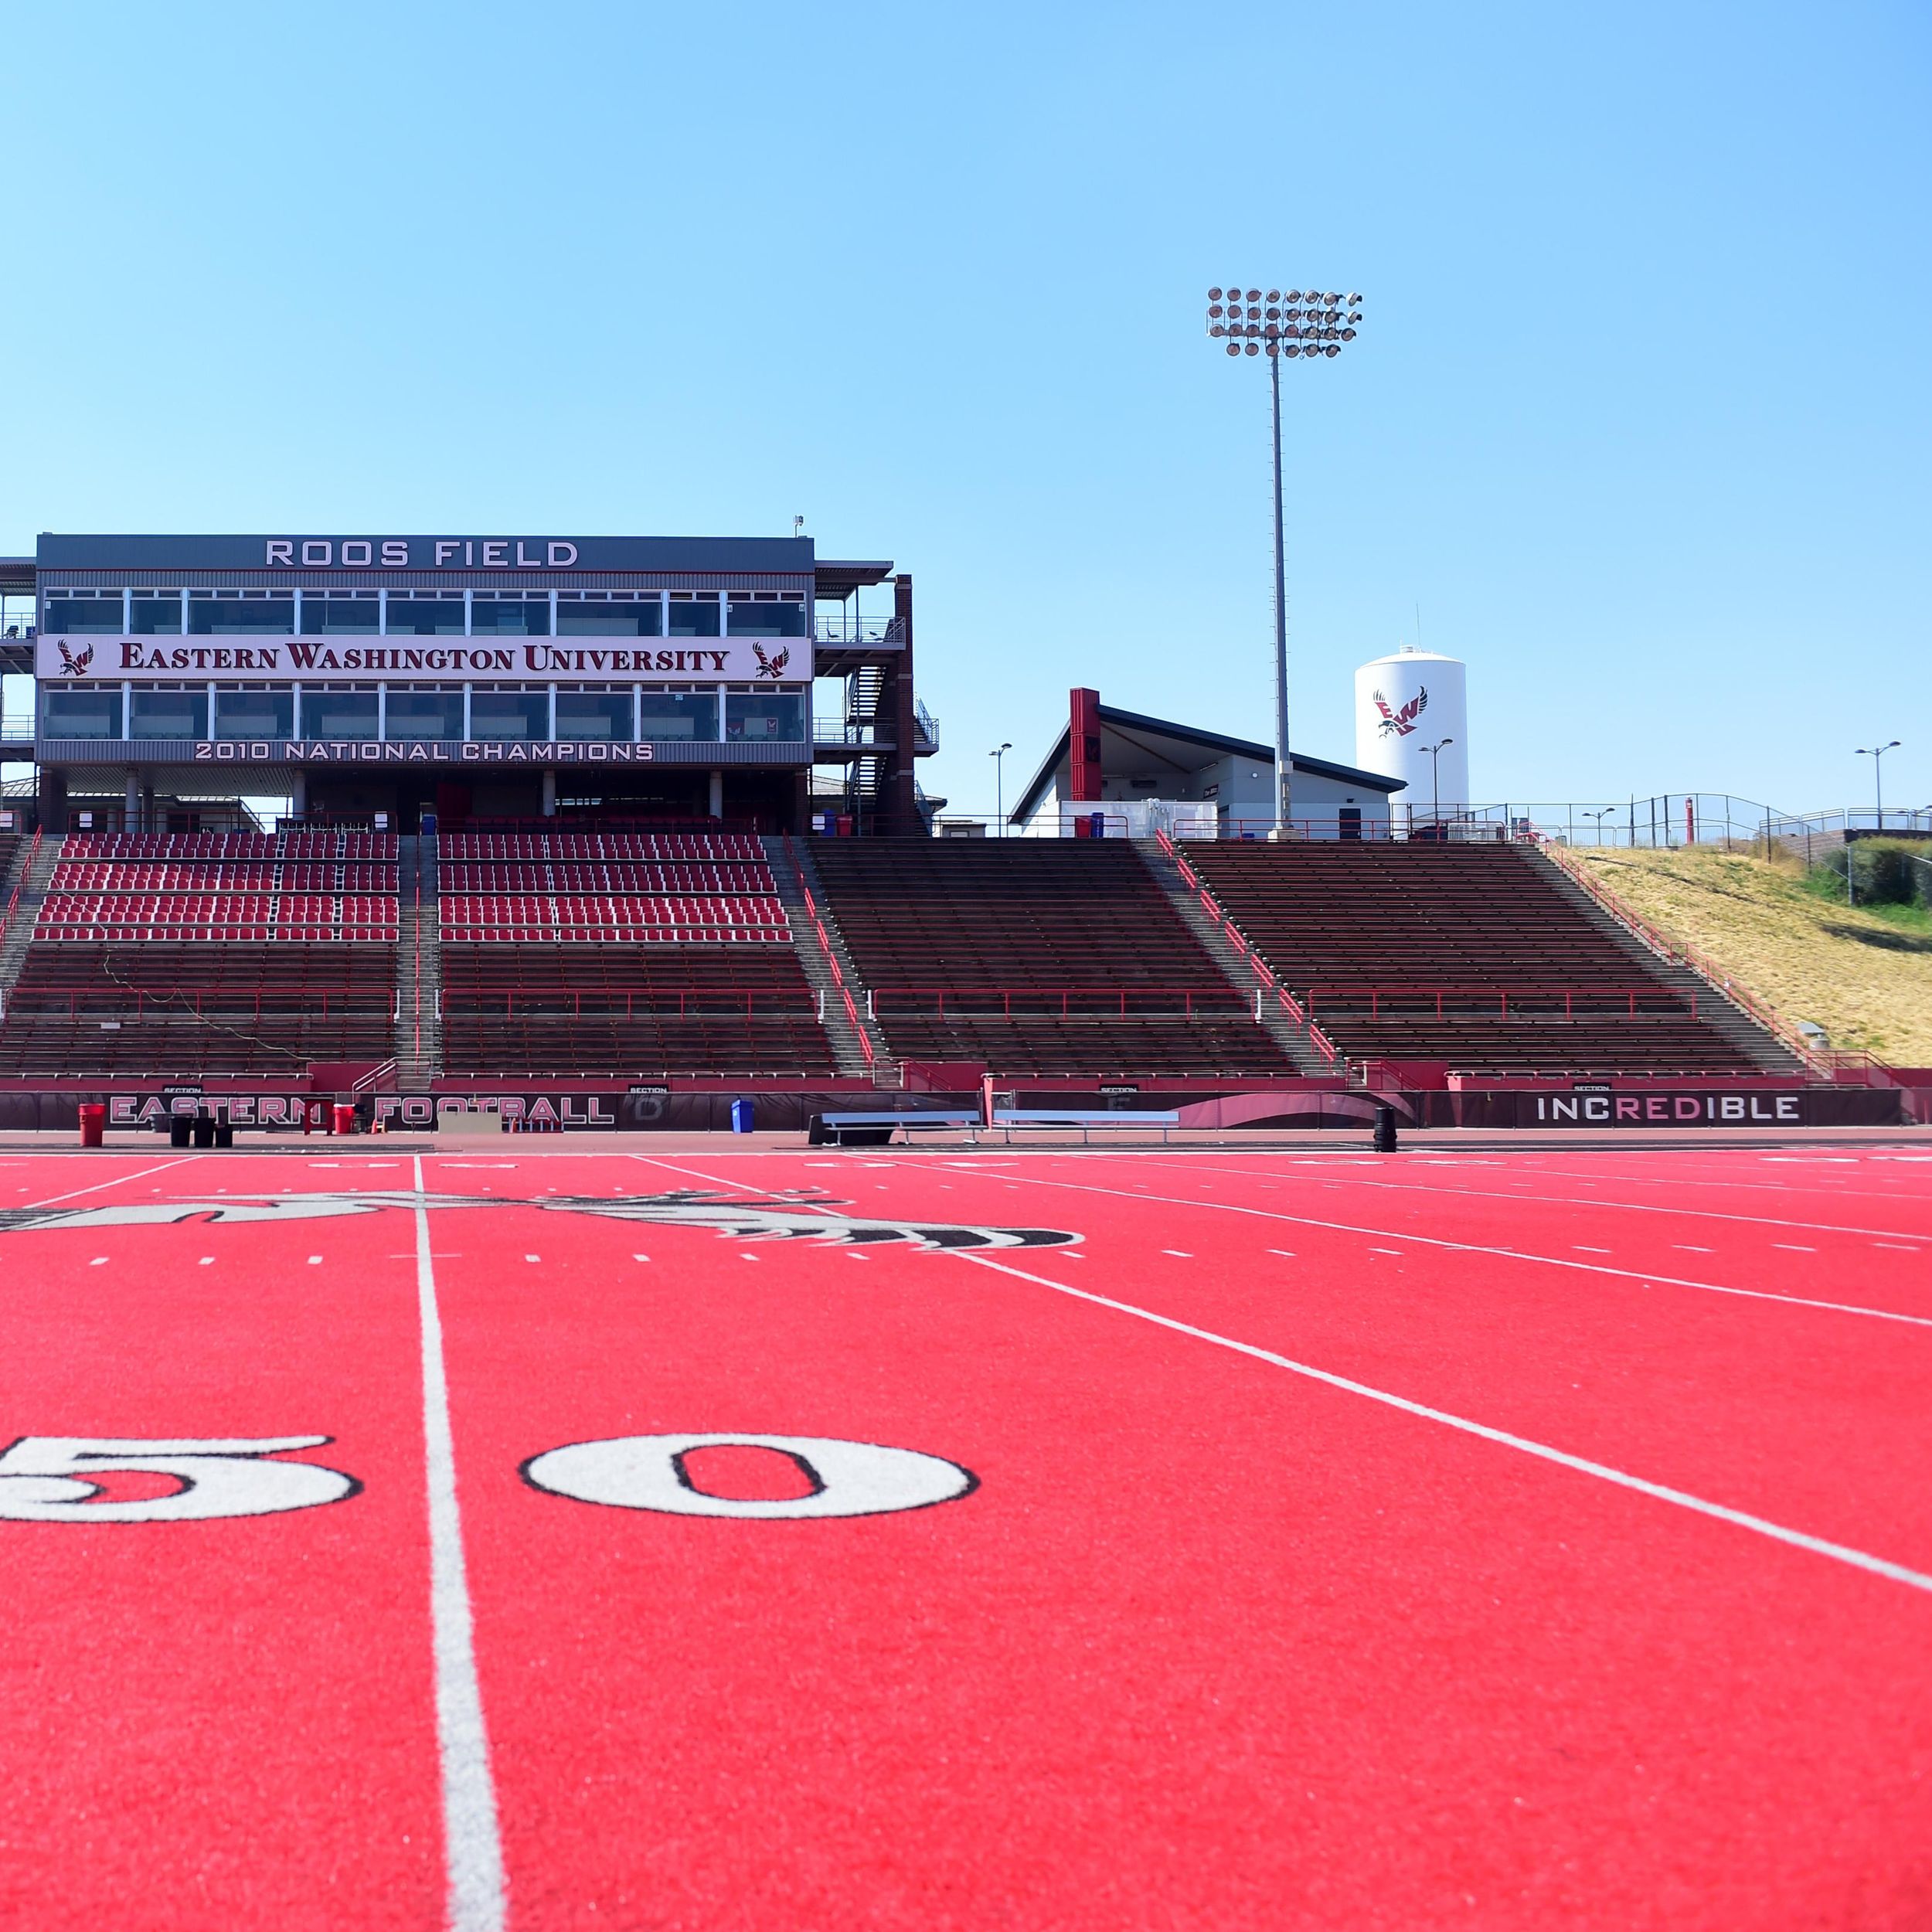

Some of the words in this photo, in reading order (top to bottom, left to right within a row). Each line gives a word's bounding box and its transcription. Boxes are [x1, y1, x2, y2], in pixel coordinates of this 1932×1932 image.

[267, 540, 408, 566] ROOS
[435, 541, 578, 566] FIELD
[119, 643, 281, 669] EASTERN
[285, 643, 516, 670] WASHINGTON
[523, 645, 730, 672] UNIVERSITY
[194, 742, 270, 760] 2010
[285, 742, 449, 761] NATIONAL
[462, 743, 654, 762] CHAMPIONS
[110, 1097, 321, 1124] EASTERN
[375, 1097, 614, 1124] FOOTBALL
[1538, 1097, 1799, 1120] INCREDIBLE
